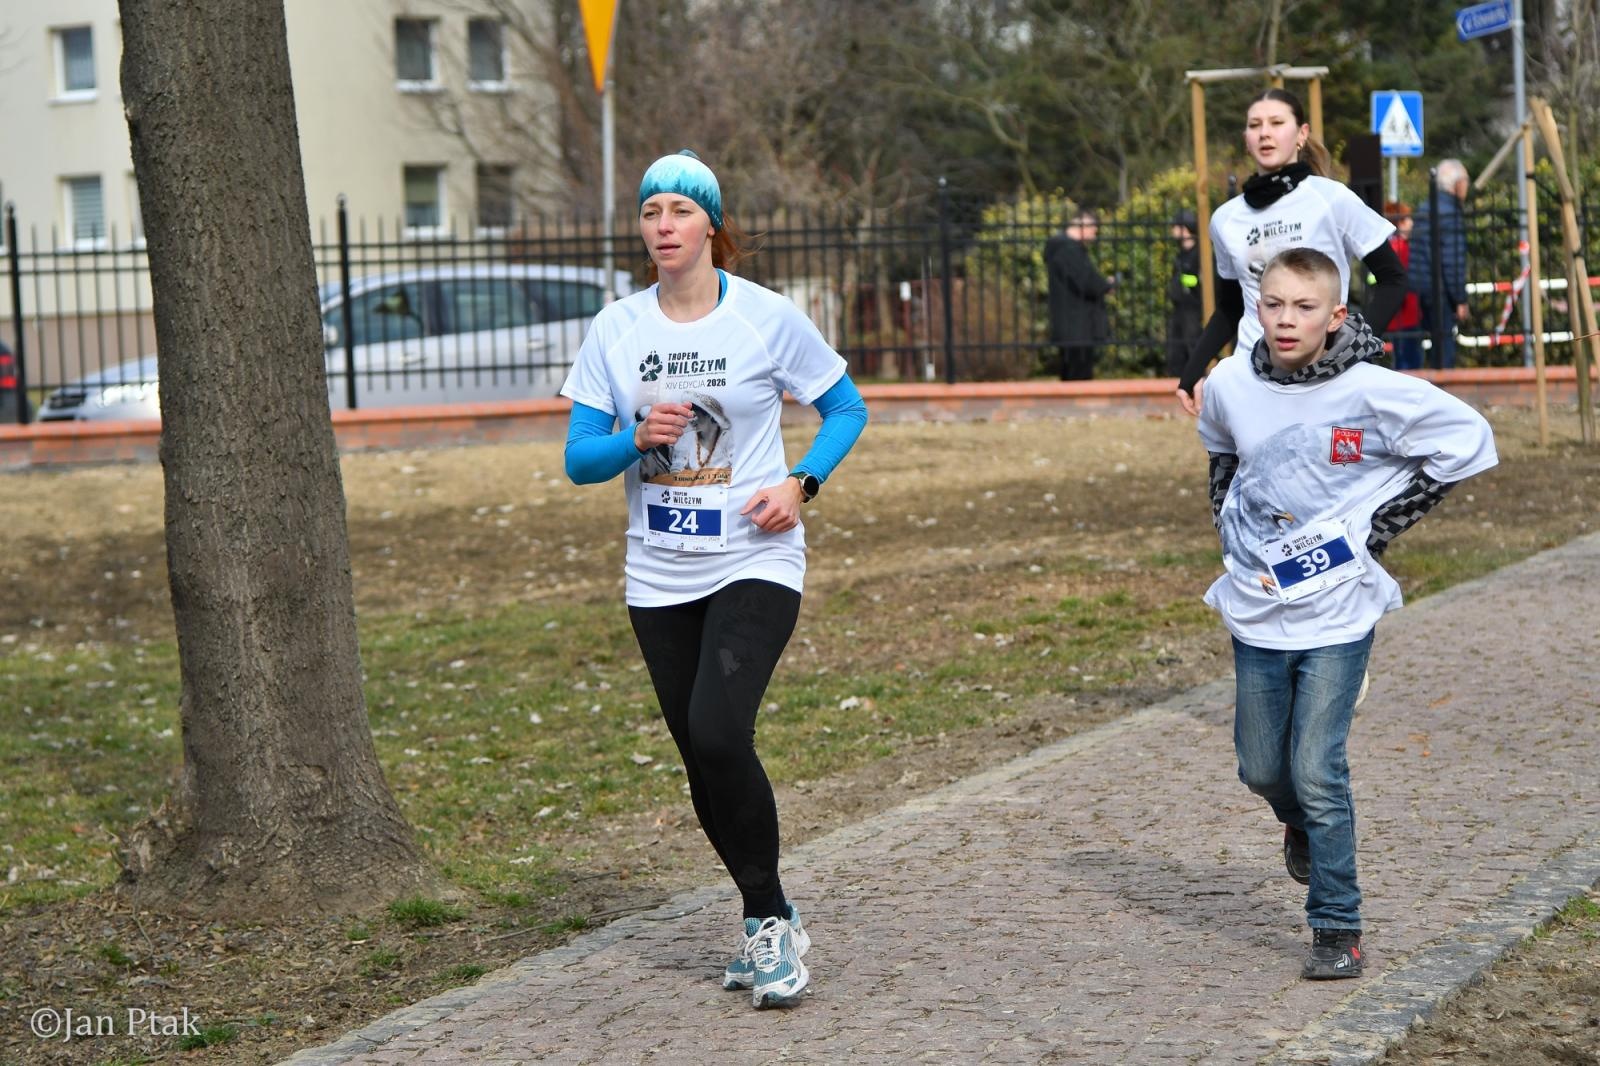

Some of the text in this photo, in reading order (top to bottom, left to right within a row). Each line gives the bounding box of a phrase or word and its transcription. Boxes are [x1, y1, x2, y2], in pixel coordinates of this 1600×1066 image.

[1264, 222, 1302, 238] WILCZYM
[668, 352, 699, 361] TROPEM
[667, 357, 727, 375] WILCZYM
[665, 378, 726, 390] XIV EDYCJA 2026
[673, 496, 702, 505] WILCZYM
[668, 509, 699, 534] 24
[1294, 533, 1324, 551] WILCZYM
[1295, 548, 1331, 578] 39
